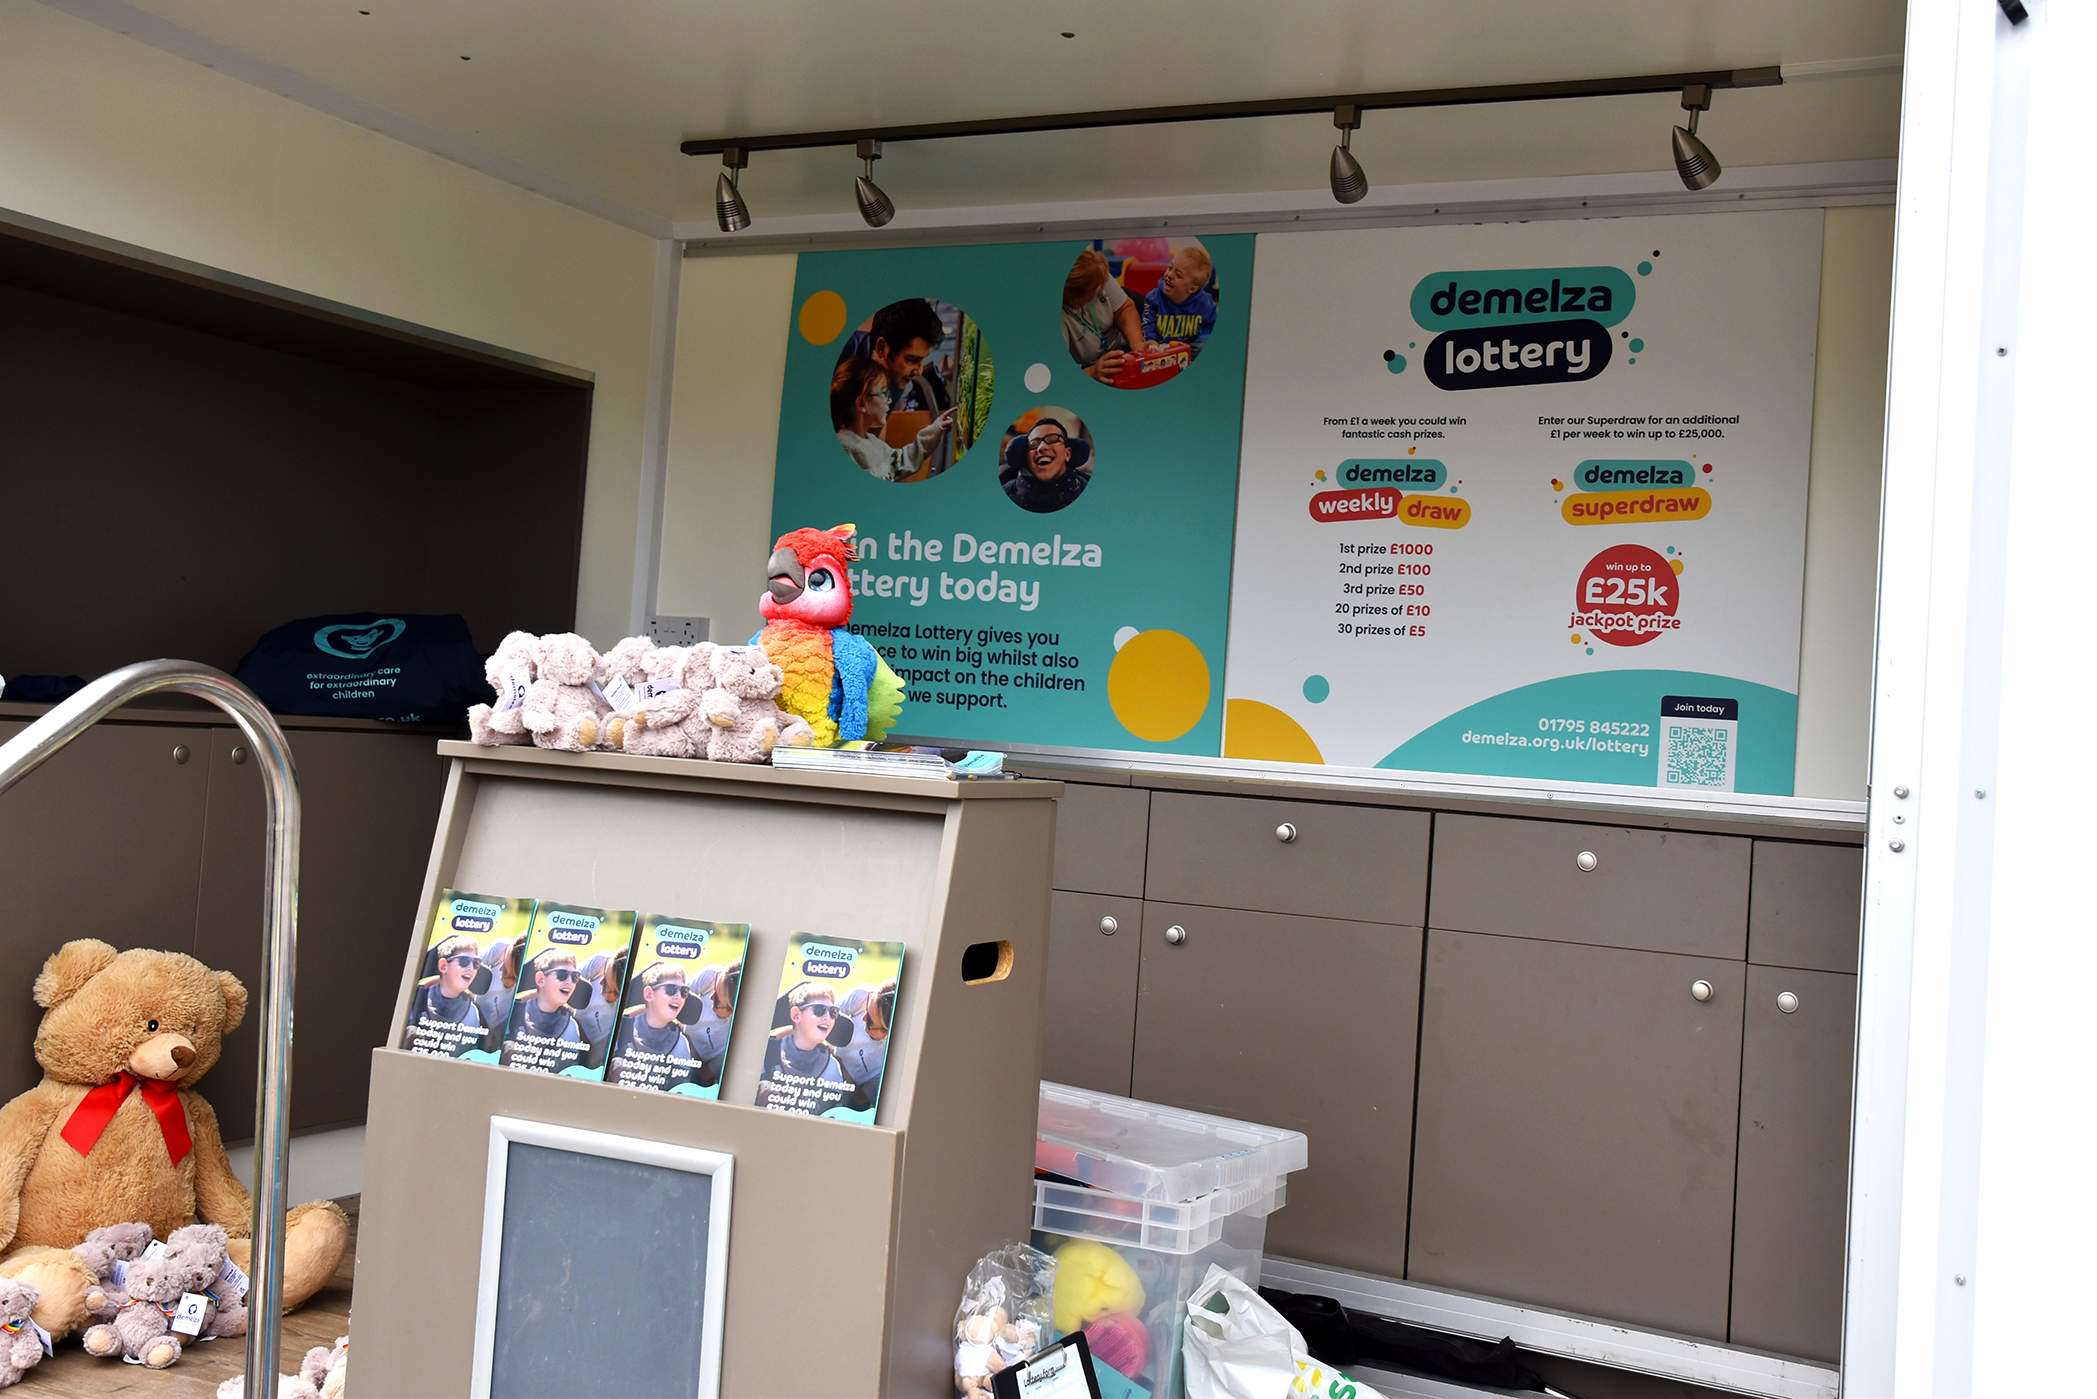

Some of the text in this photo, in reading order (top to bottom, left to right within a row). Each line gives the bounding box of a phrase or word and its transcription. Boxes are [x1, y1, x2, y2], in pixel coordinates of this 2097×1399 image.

[1429, 278, 1613, 317] demelza
[1156, 314, 1202, 338] MAZING
[1445, 339, 1592, 374] lottery
[1323, 417, 1348, 426] From
[1350, 417, 1360, 426] £1
[1370, 416, 1396, 425] week
[1398, 419, 1417, 428] you
[1418, 416, 1447, 425] could
[1450, 416, 1467, 425] win
[1538, 414, 1740, 427] Enter our Superdraw for an additional
[1342, 430, 1446, 441] fantastic cash prizes.
[1550, 429, 1725, 441] £1 per week to win up to £25,000.
[1345, 464, 1436, 483] demelza
[1584, 465, 1684, 484] demelza
[1318, 492, 1462, 521] weekly draw
[1572, 495, 1700, 520] superdraw
[850, 529, 1102, 568] in the Demelza
[1340, 543, 1433, 557] 1st prize £1000
[1339, 563, 1431, 577] 2nd prize £100
[1606, 562, 1652, 572] win up to
[846, 568, 1040, 611] ttery today
[1343, 583, 1425, 597] 3rd prize £50
[1585, 577, 1668, 606] £25k
[1335, 603, 1431, 617] 20 prizes of £10
[1568, 612, 1681, 631] jackpot prize
[915, 624, 973, 646] Lottery
[977, 629, 1023, 651] gives
[1027, 633, 1059, 649] you
[1338, 623, 1426, 637] 30 prizes of £5
[901, 645, 918, 660] to
[922, 645, 951, 661] win
[956, 647, 982, 668] big
[989, 650, 1038, 668] whilst
[1042, 652, 1079, 669] also
[377, 667, 401, 675] care
[310, 678, 397, 689] for extraordinary
[954, 672, 976, 684] on
[980, 670, 1009, 687] the
[1014, 673, 1085, 691] children
[332, 690, 375, 699] children
[908, 690, 1008, 710] we support.
[1674, 703, 1725, 715] Join today
[1538, 718, 1650, 736] 01795 845222
[1462, 730, 1649, 757] demelza.org.uk/lottery
[455, 902, 497, 917] demelza
[455, 917, 490, 932] lottery
[552, 914, 595, 929] demelza
[552, 930, 589, 945] lottery
[660, 928, 704, 943] demelza
[660, 942, 698, 957] lottery
[806, 946, 853, 962] demelza
[807, 961, 847, 976] lottery
[418, 1016, 489, 1035] Support Demelza
[416, 1027, 477, 1044] today and you
[516, 1031, 590, 1051] Support Demelza
[413, 1038, 456, 1051] could win
[514, 1042, 578, 1060] today and you
[511, 1053, 555, 1067] could win
[625, 1047, 702, 1068] Support Demelza
[622, 1059, 689, 1077] today and you
[620, 1070, 665, 1085] could win
[772, 1070, 856, 1092] Support Demelza
[770, 1081, 841, 1102] today and you
[767, 1094, 816, 1109] could win
